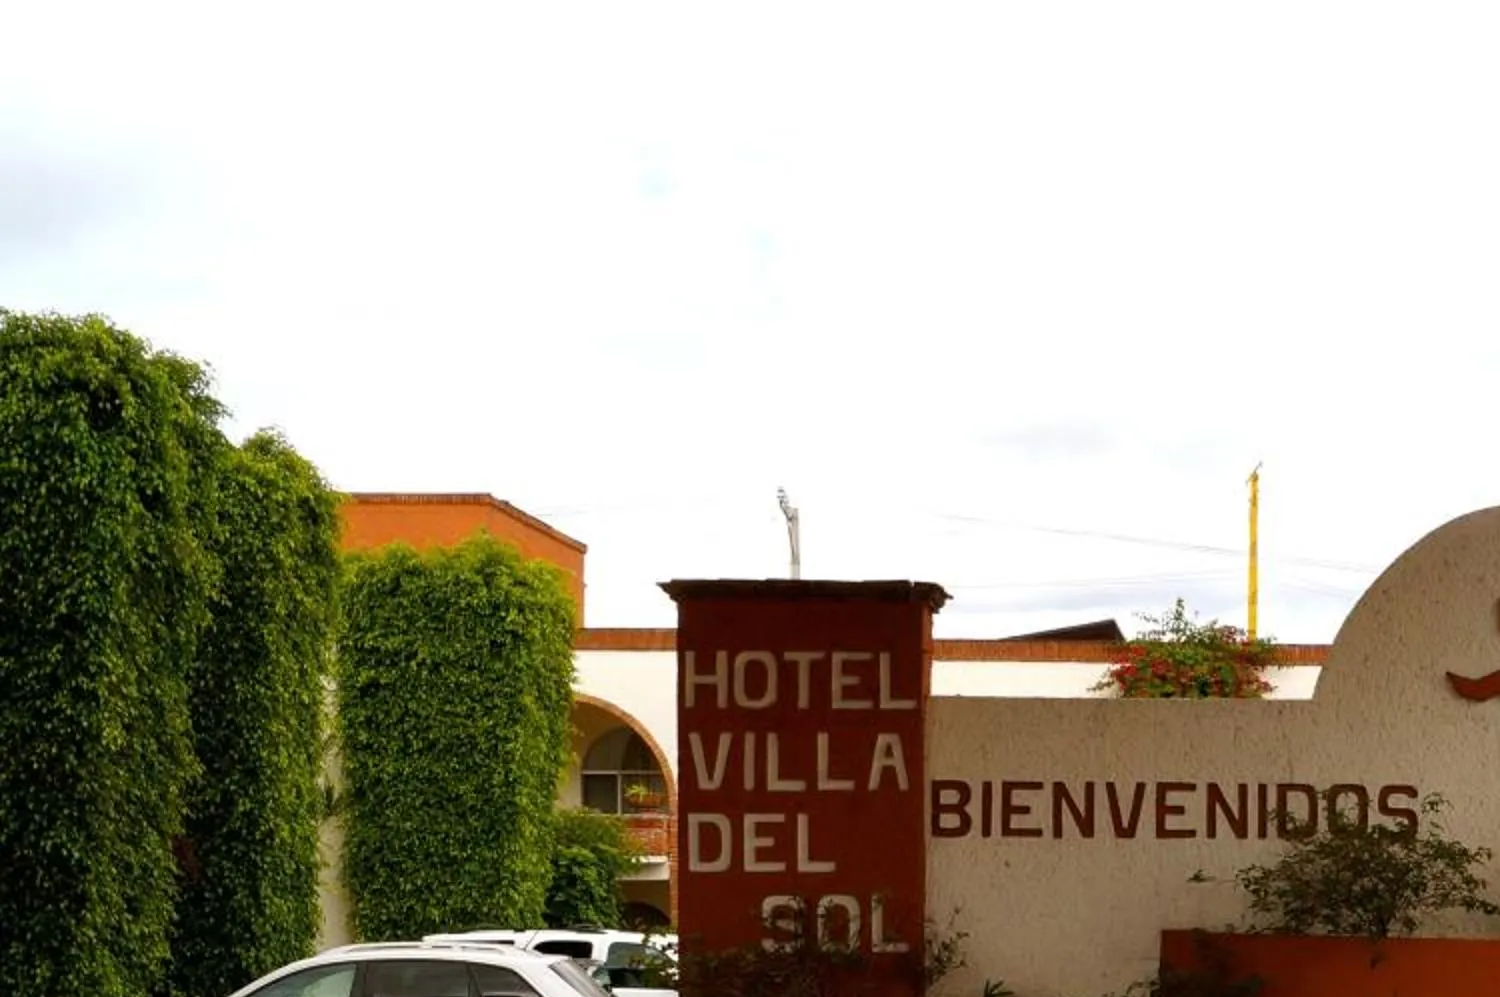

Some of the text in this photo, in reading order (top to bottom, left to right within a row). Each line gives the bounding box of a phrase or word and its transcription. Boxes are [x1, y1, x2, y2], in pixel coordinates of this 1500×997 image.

[684, 650, 918, 710] HOTEL
[688, 731, 910, 792] VILLA
[930, 779, 1420, 842] BIENVENIDOS
[687, 812, 837, 873] DEL
[761, 893, 910, 954] SOL
